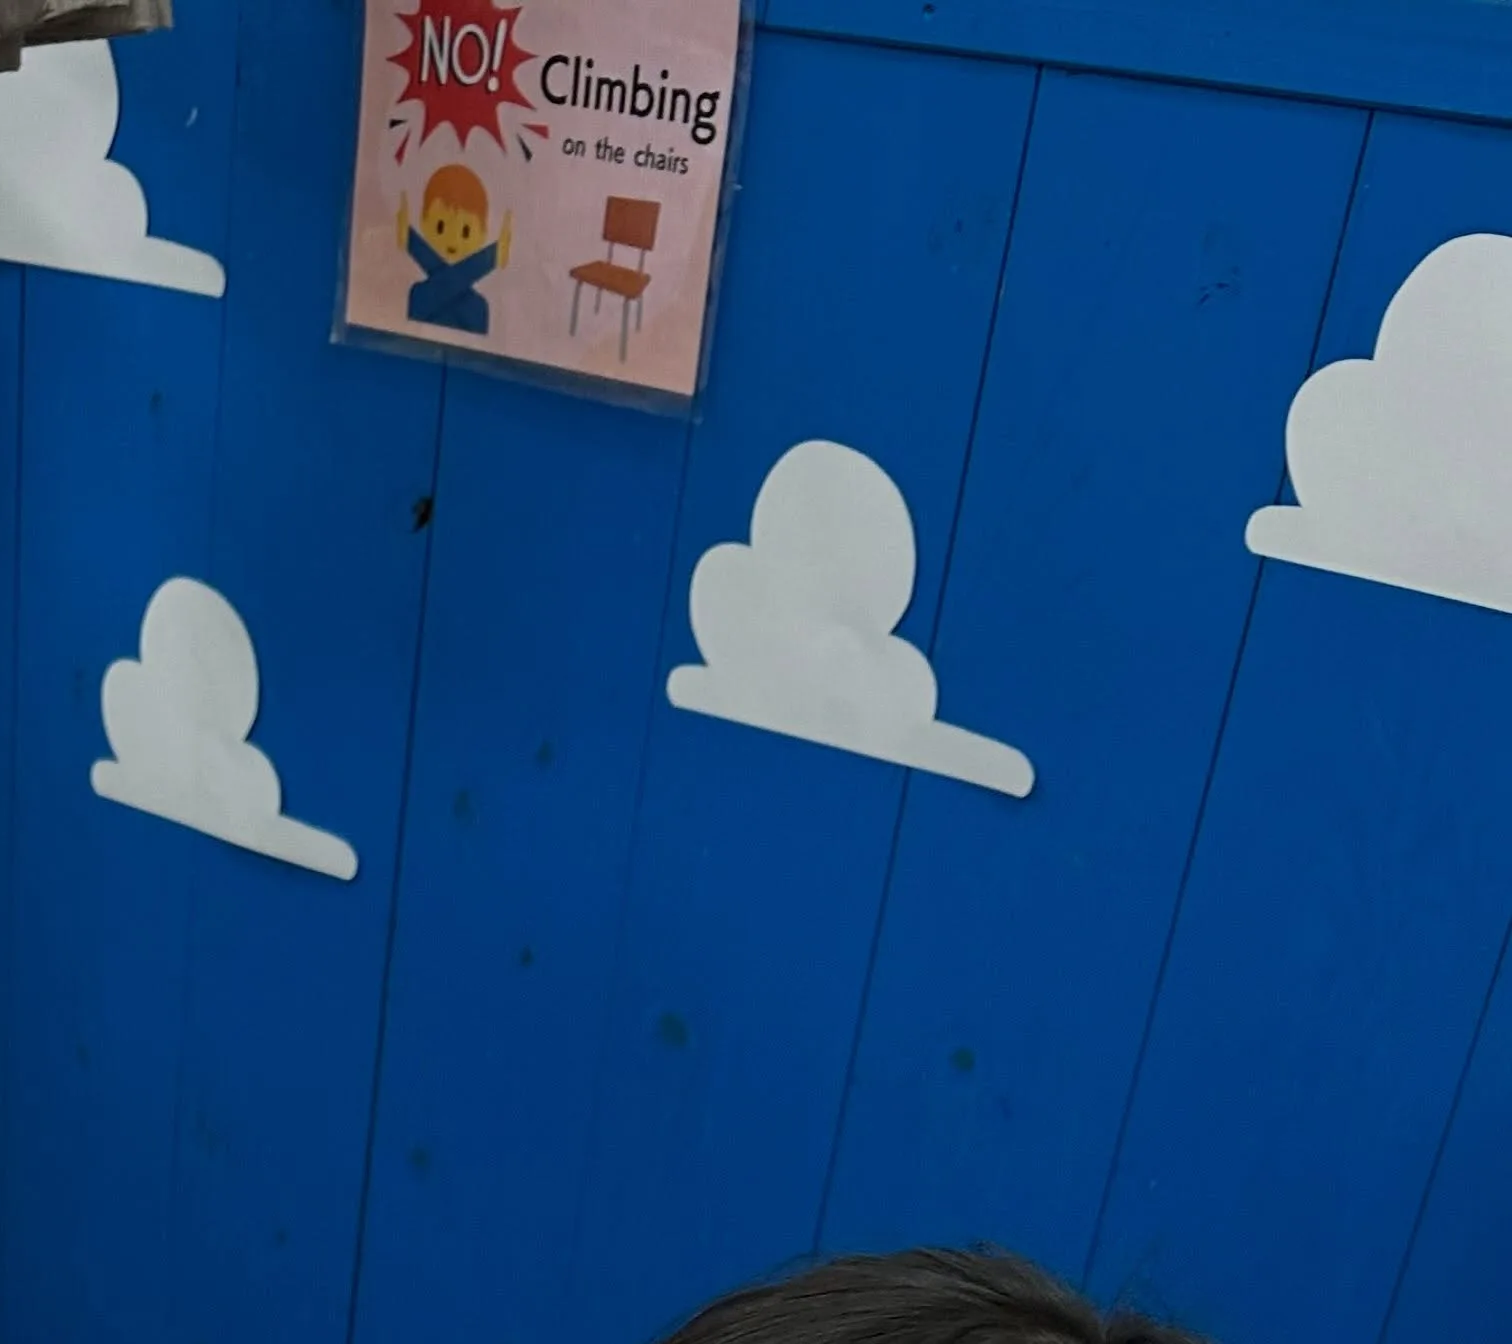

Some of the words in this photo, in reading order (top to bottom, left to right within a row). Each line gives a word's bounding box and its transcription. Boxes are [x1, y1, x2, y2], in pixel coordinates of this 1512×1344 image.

[419, 15, 508, 92] NO!
[540, 54, 720, 145] Climbing
[563, 138, 586, 157] on
[595, 136, 625, 164] the
[633, 143, 689, 174] chairs
